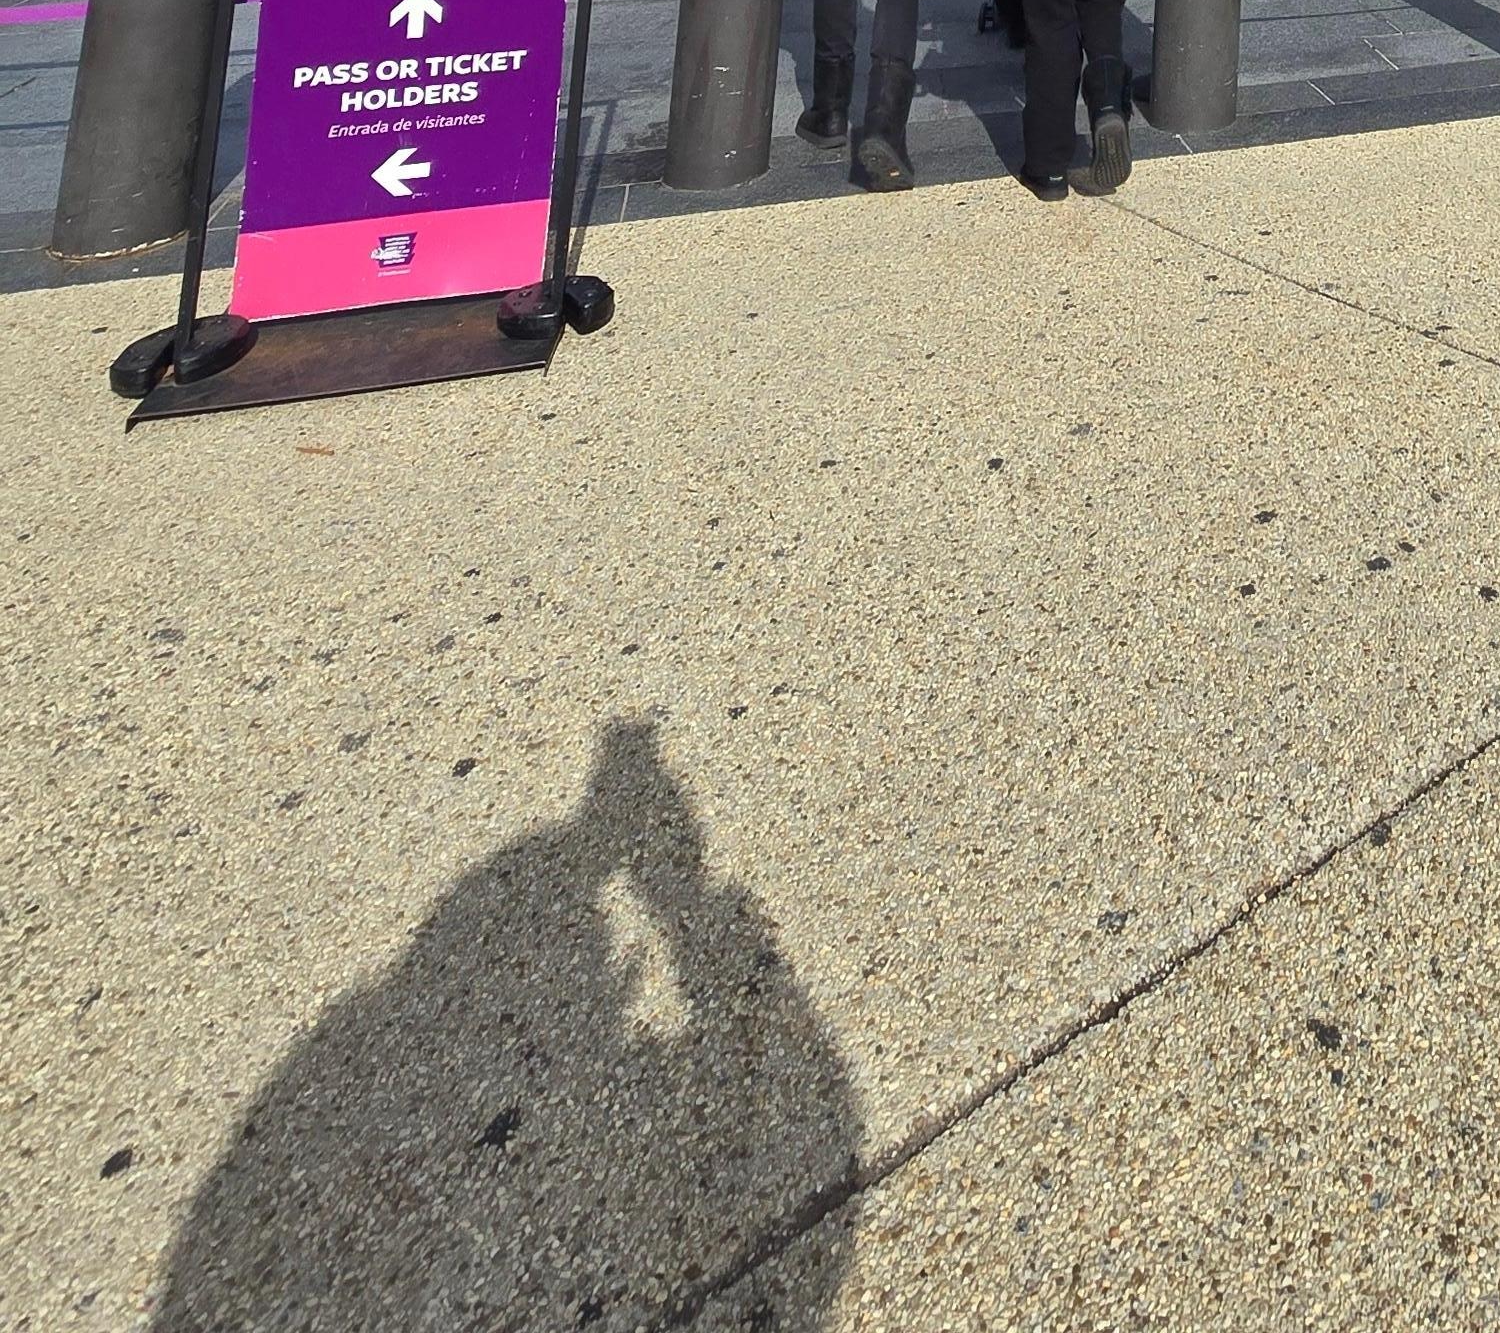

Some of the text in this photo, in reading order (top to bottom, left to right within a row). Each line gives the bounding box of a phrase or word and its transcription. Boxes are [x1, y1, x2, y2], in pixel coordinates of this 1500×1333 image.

[293, 49, 528, 88] PASS OR TICKET
[340, 81, 478, 112] HOLDERS
[328, 112, 486, 139] Entrada de visitantes
